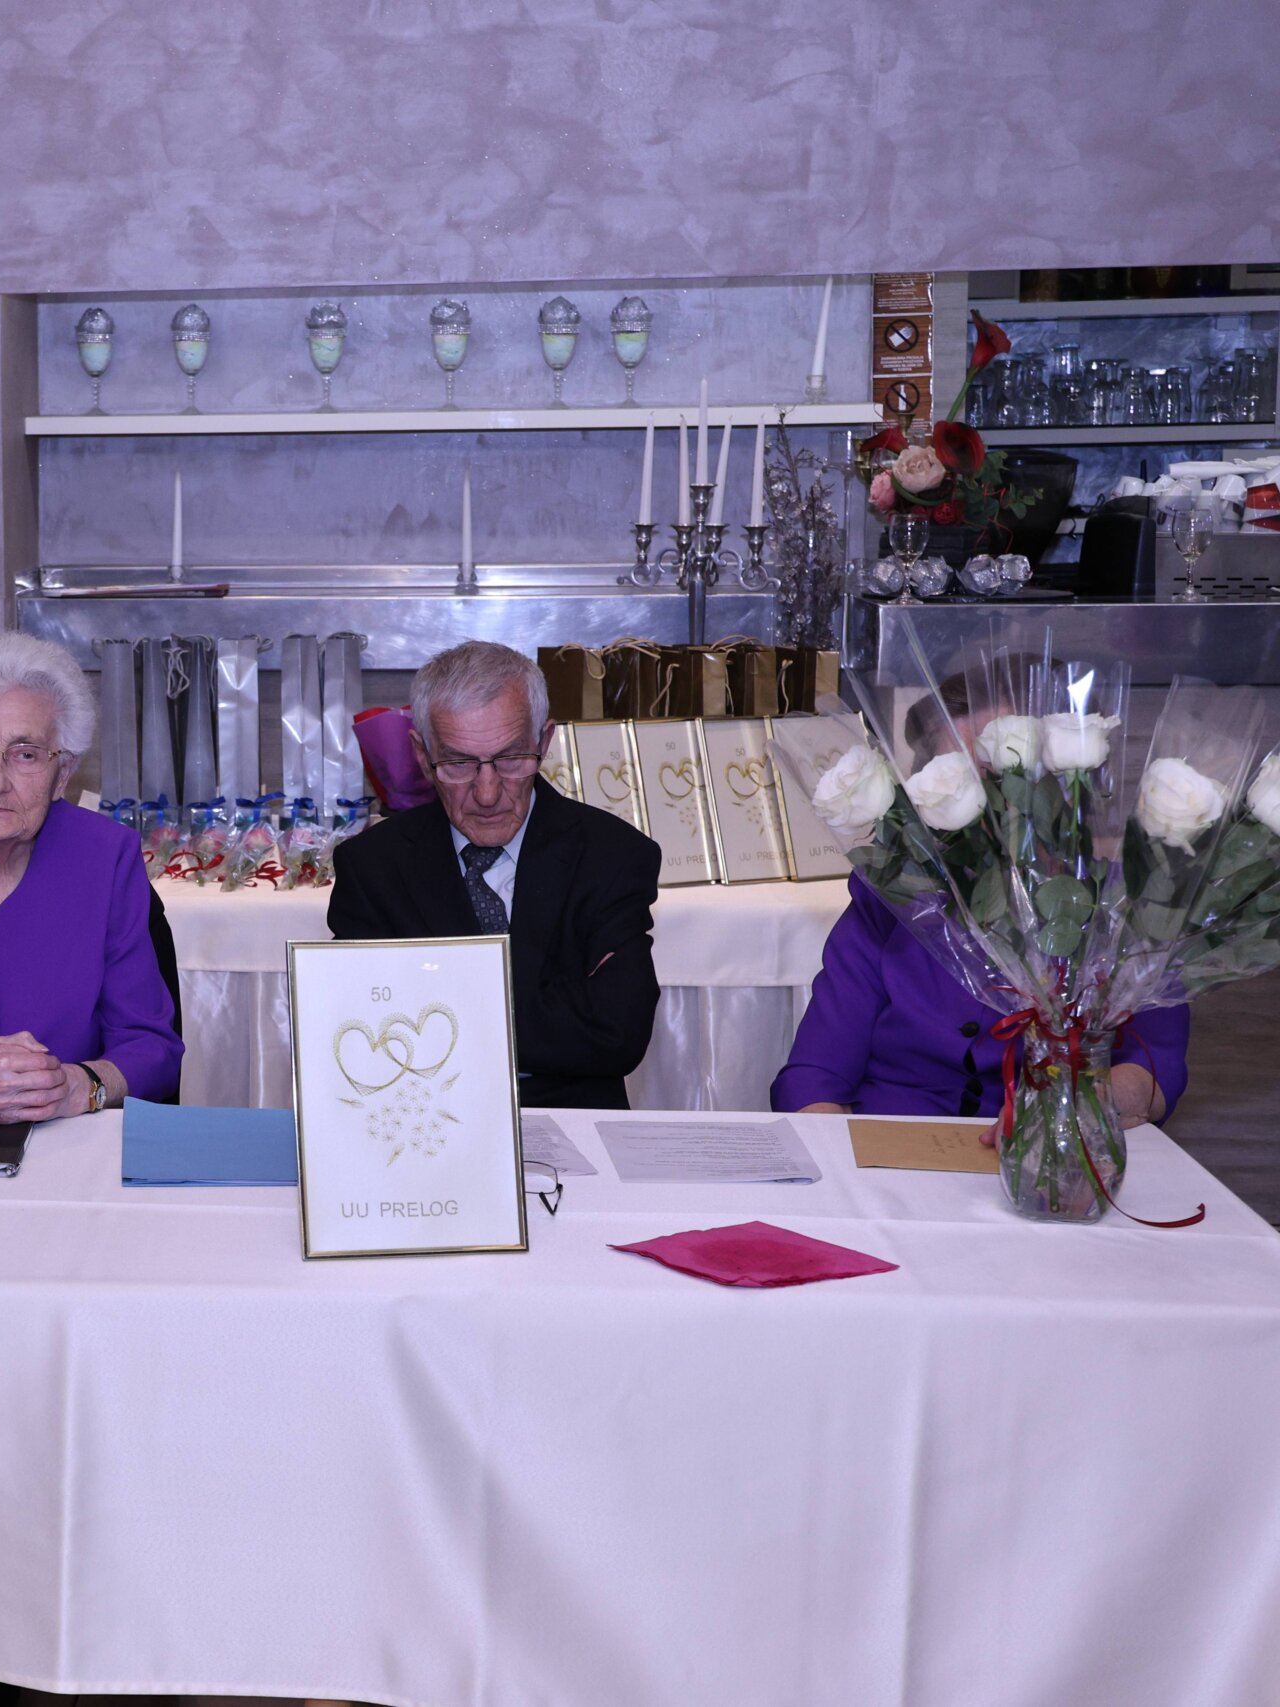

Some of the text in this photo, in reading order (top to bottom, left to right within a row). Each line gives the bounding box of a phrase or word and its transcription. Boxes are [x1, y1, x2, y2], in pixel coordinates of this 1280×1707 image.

[667, 856, 682, 867] UU
[371, 986, 392, 1002] 50
[341, 1199, 459, 1218] UU PRELOG
